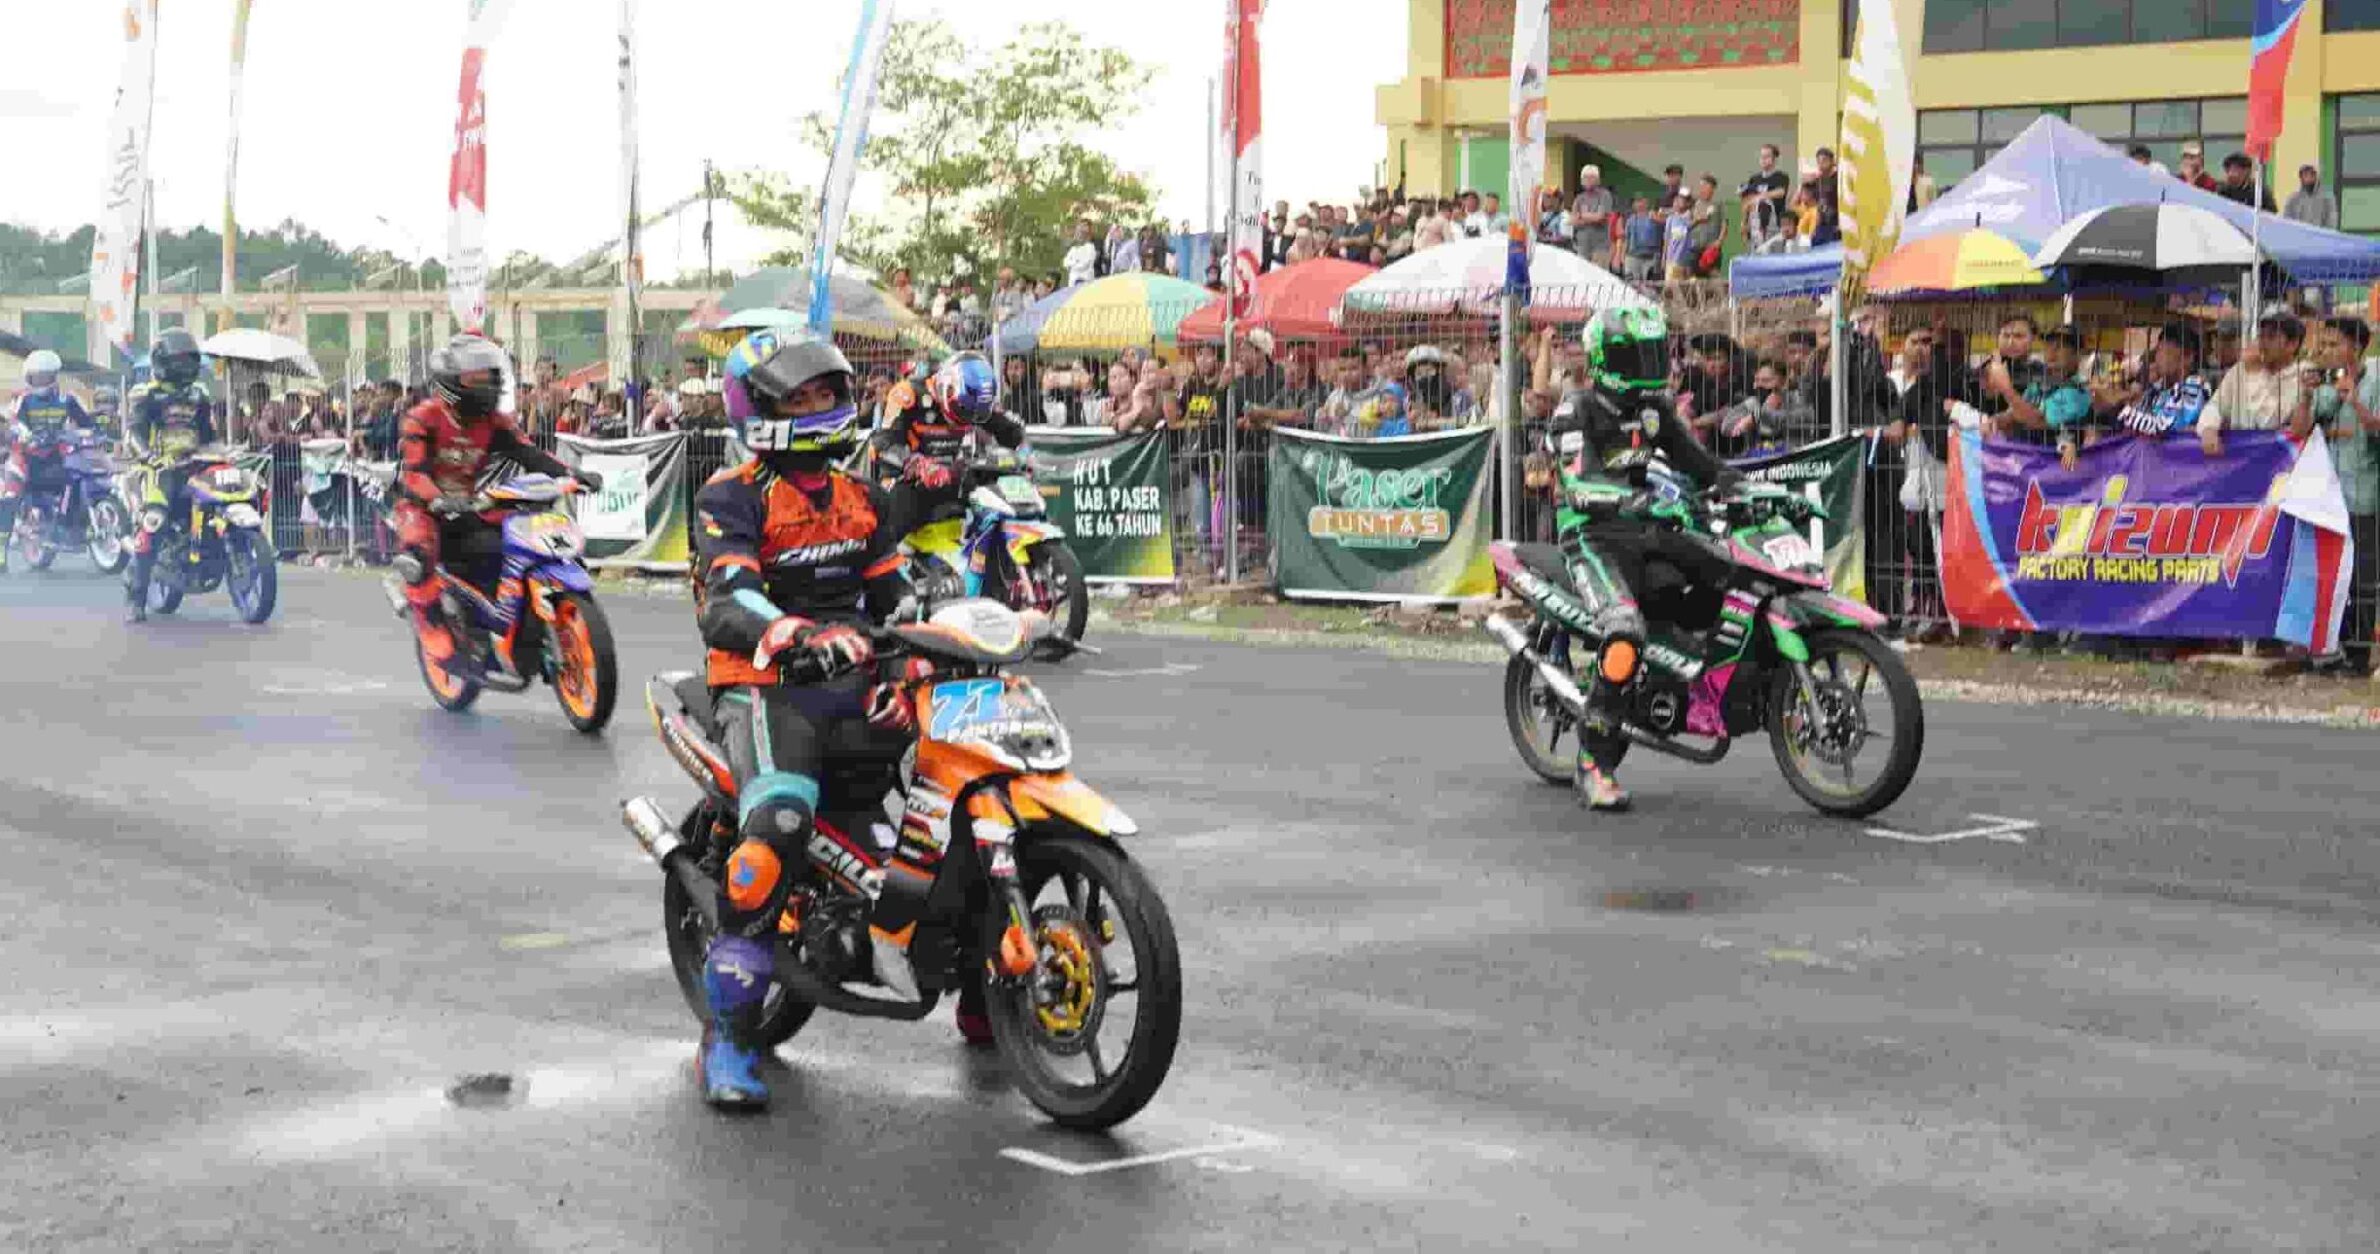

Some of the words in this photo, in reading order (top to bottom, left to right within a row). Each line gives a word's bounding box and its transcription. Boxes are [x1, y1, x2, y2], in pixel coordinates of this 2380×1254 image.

[1074, 458, 1111, 485] HUT
[1111, 485, 1160, 511] PASER
[1075, 515, 1094, 537] KE
[1096, 515, 1114, 537] 66
[1116, 513, 1161, 537] TAHUN
[1318, 509, 1439, 536] TUNTAS
[2017, 556, 2089, 581] FACTORY
[2093, 557, 2158, 583] RACING
[2162, 557, 2221, 584] PARTS
